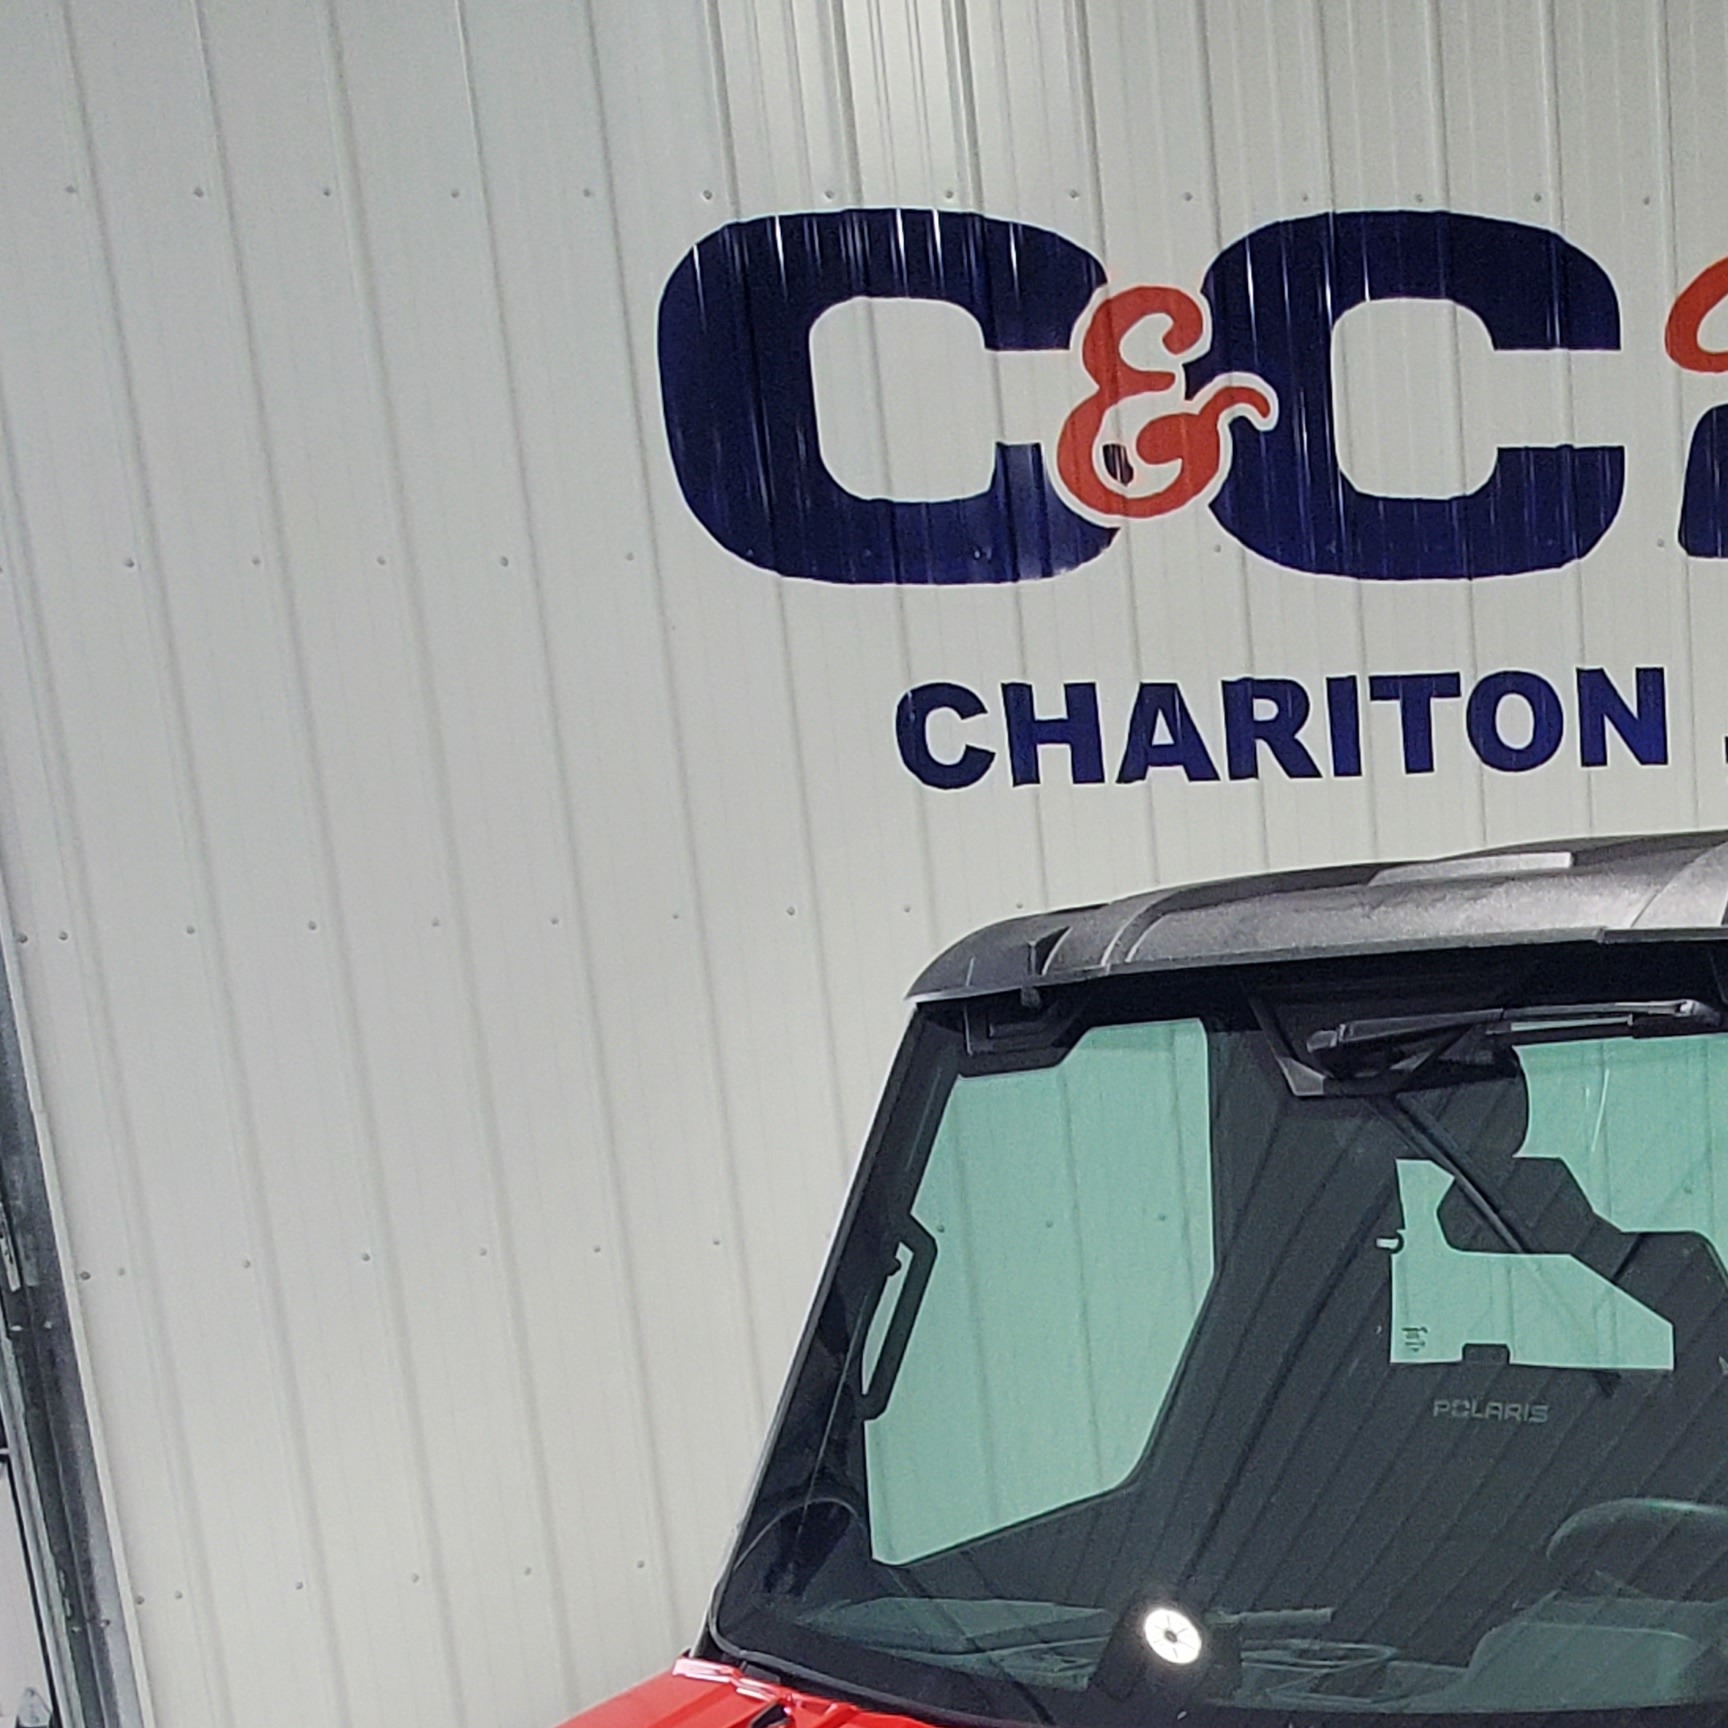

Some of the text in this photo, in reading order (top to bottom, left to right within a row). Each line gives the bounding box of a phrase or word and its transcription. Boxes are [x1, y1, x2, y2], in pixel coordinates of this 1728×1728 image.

[657, 207, 1625, 585] C&C
[894, 667, 1670, 790] CHARITON
[1432, 1399, 1550, 1424] POLARIS
